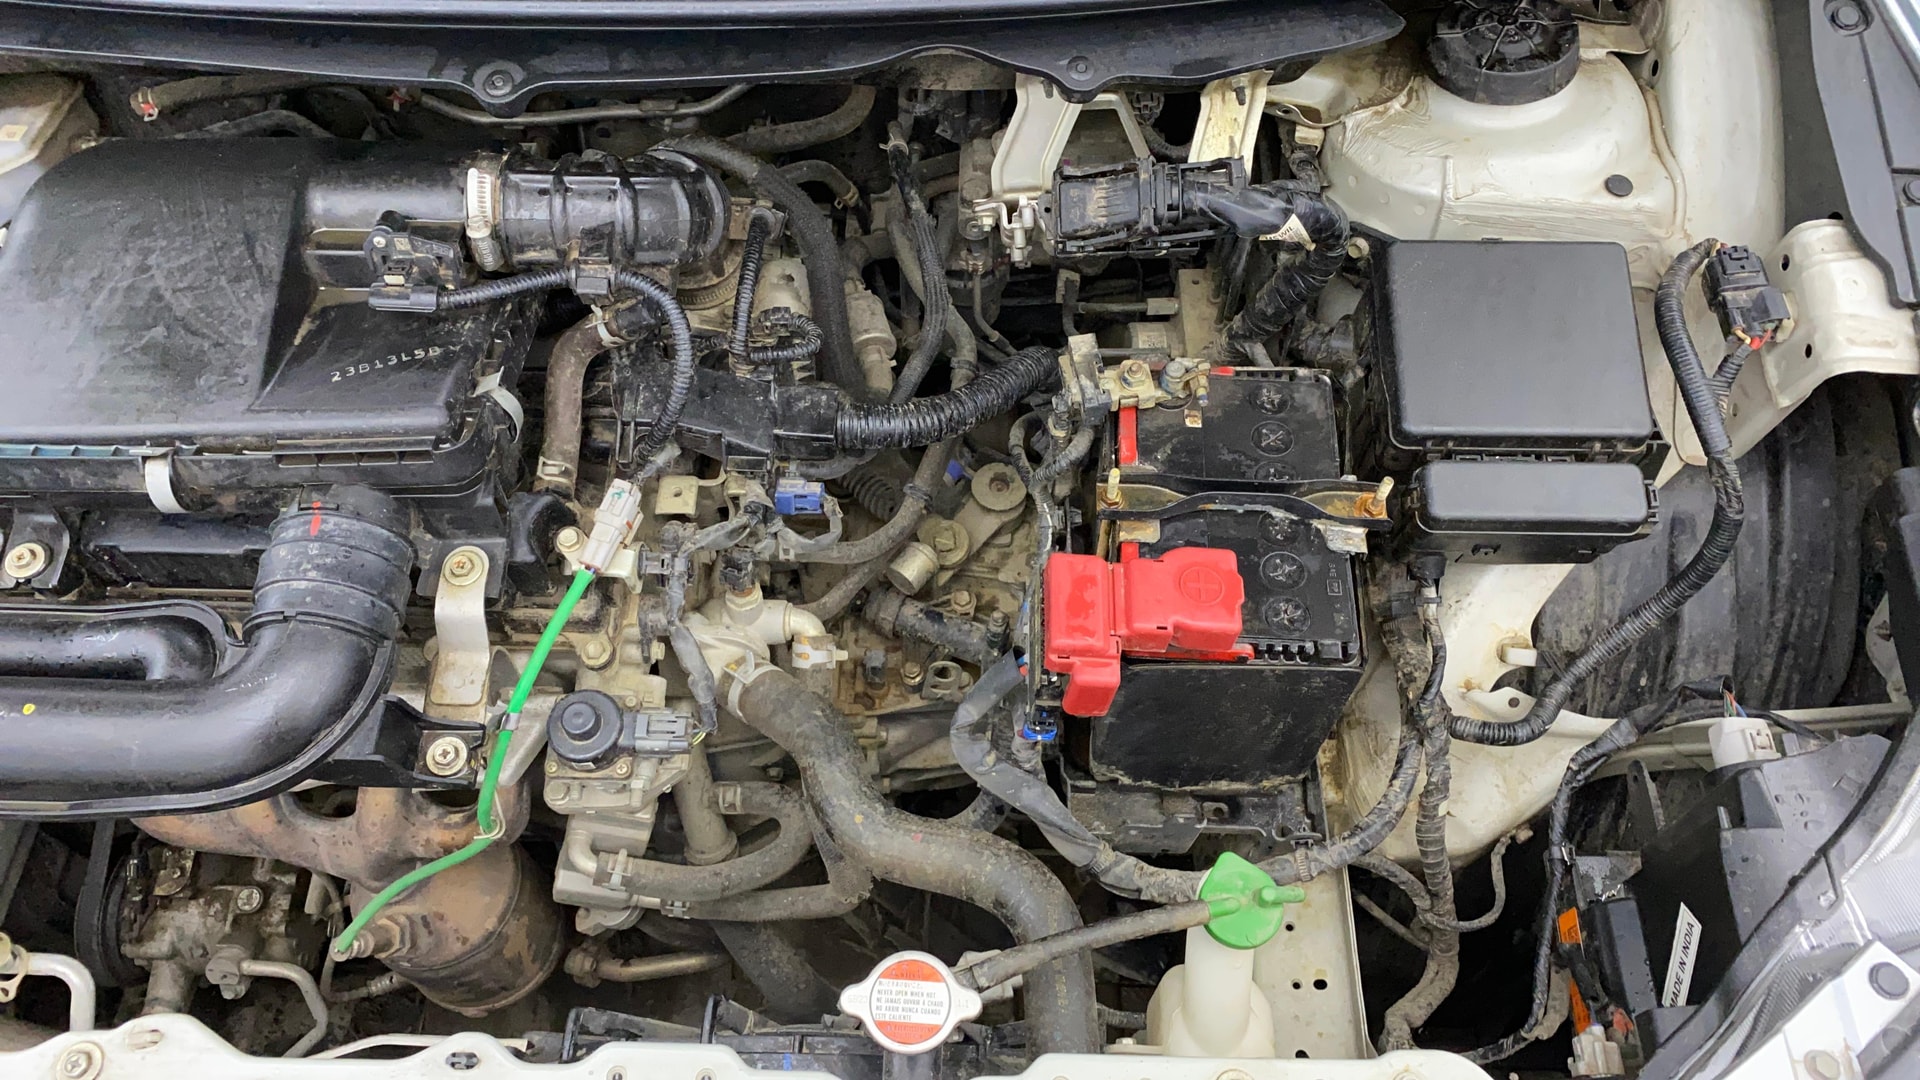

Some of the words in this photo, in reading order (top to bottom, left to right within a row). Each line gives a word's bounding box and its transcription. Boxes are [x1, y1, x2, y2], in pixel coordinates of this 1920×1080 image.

[1682, 922, 1695, 958] INDIA
[1678, 956, 1687, 974] IN
[1669, 972, 1683, 1008] MADE
[885, 1005, 899, 1013] ABRIR
[901, 1006, 919, 1014] NUNCA
